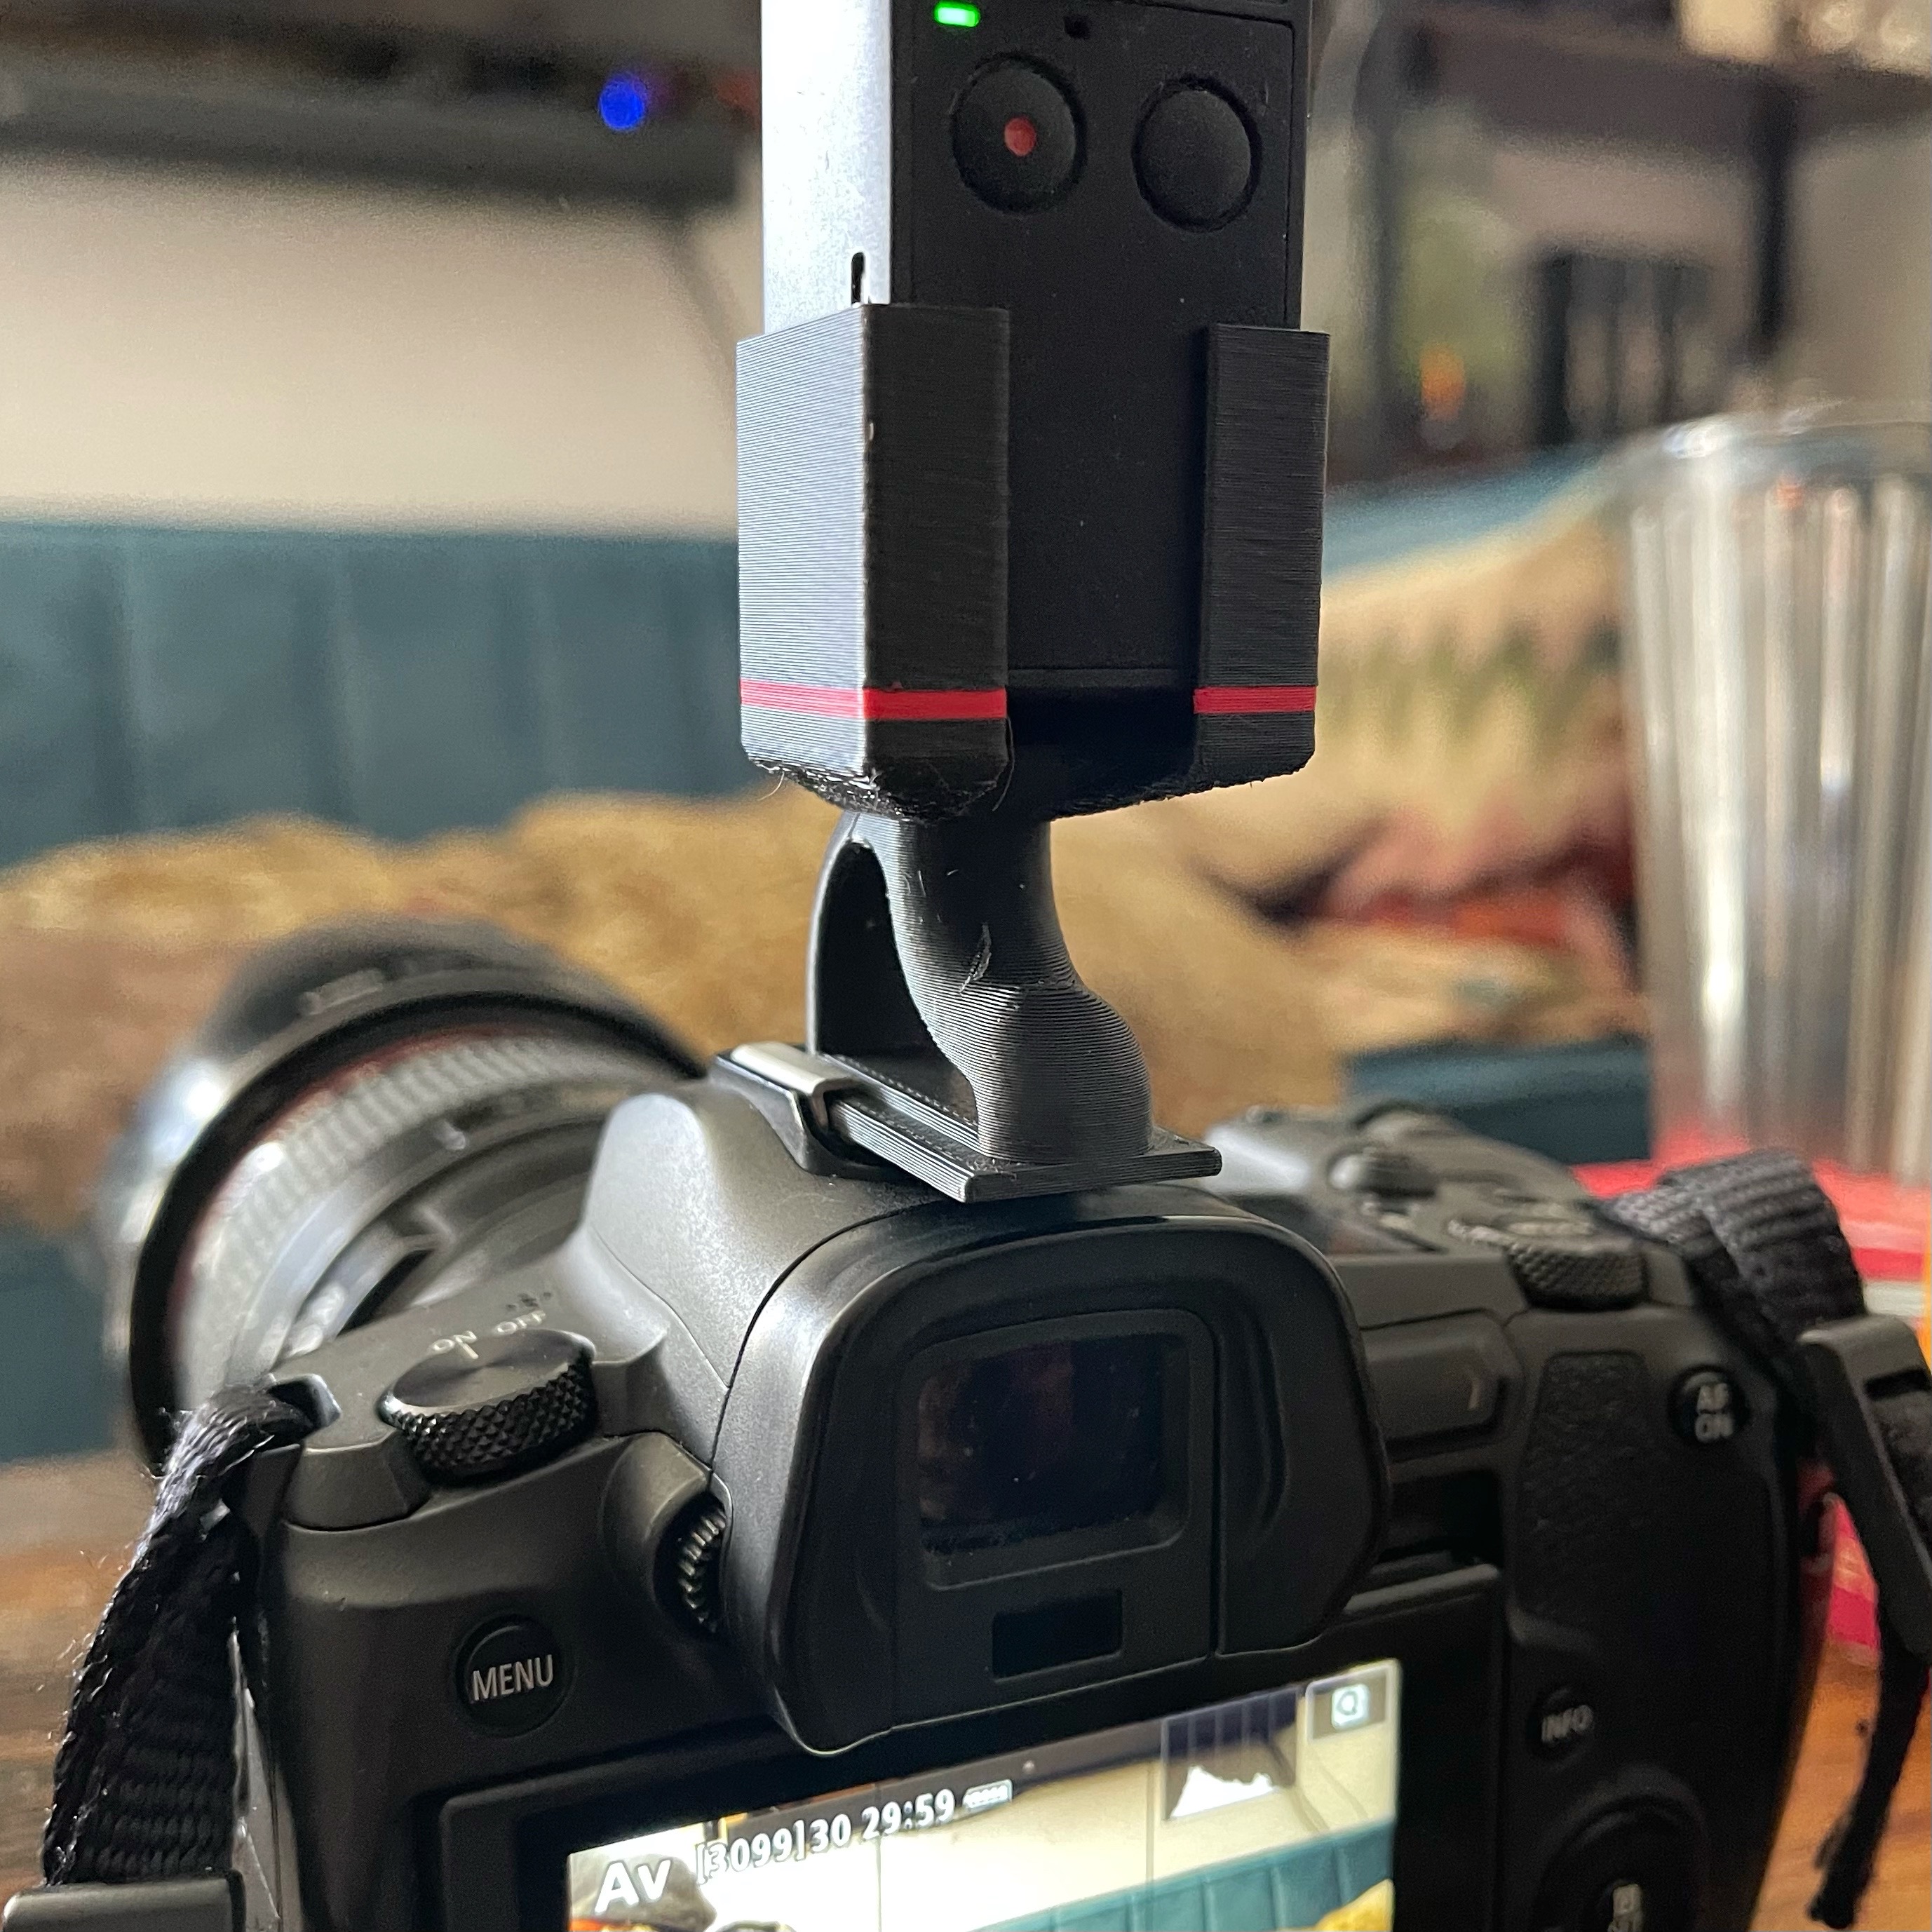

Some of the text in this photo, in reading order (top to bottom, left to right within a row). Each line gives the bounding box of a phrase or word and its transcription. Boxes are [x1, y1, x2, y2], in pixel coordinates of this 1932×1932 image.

[430, 1330, 478, 1354] ON
[471, 1654, 553, 1701] MENU
[860, 1788, 956, 1841] 29:59
[593, 1857, 673, 1915] Av
